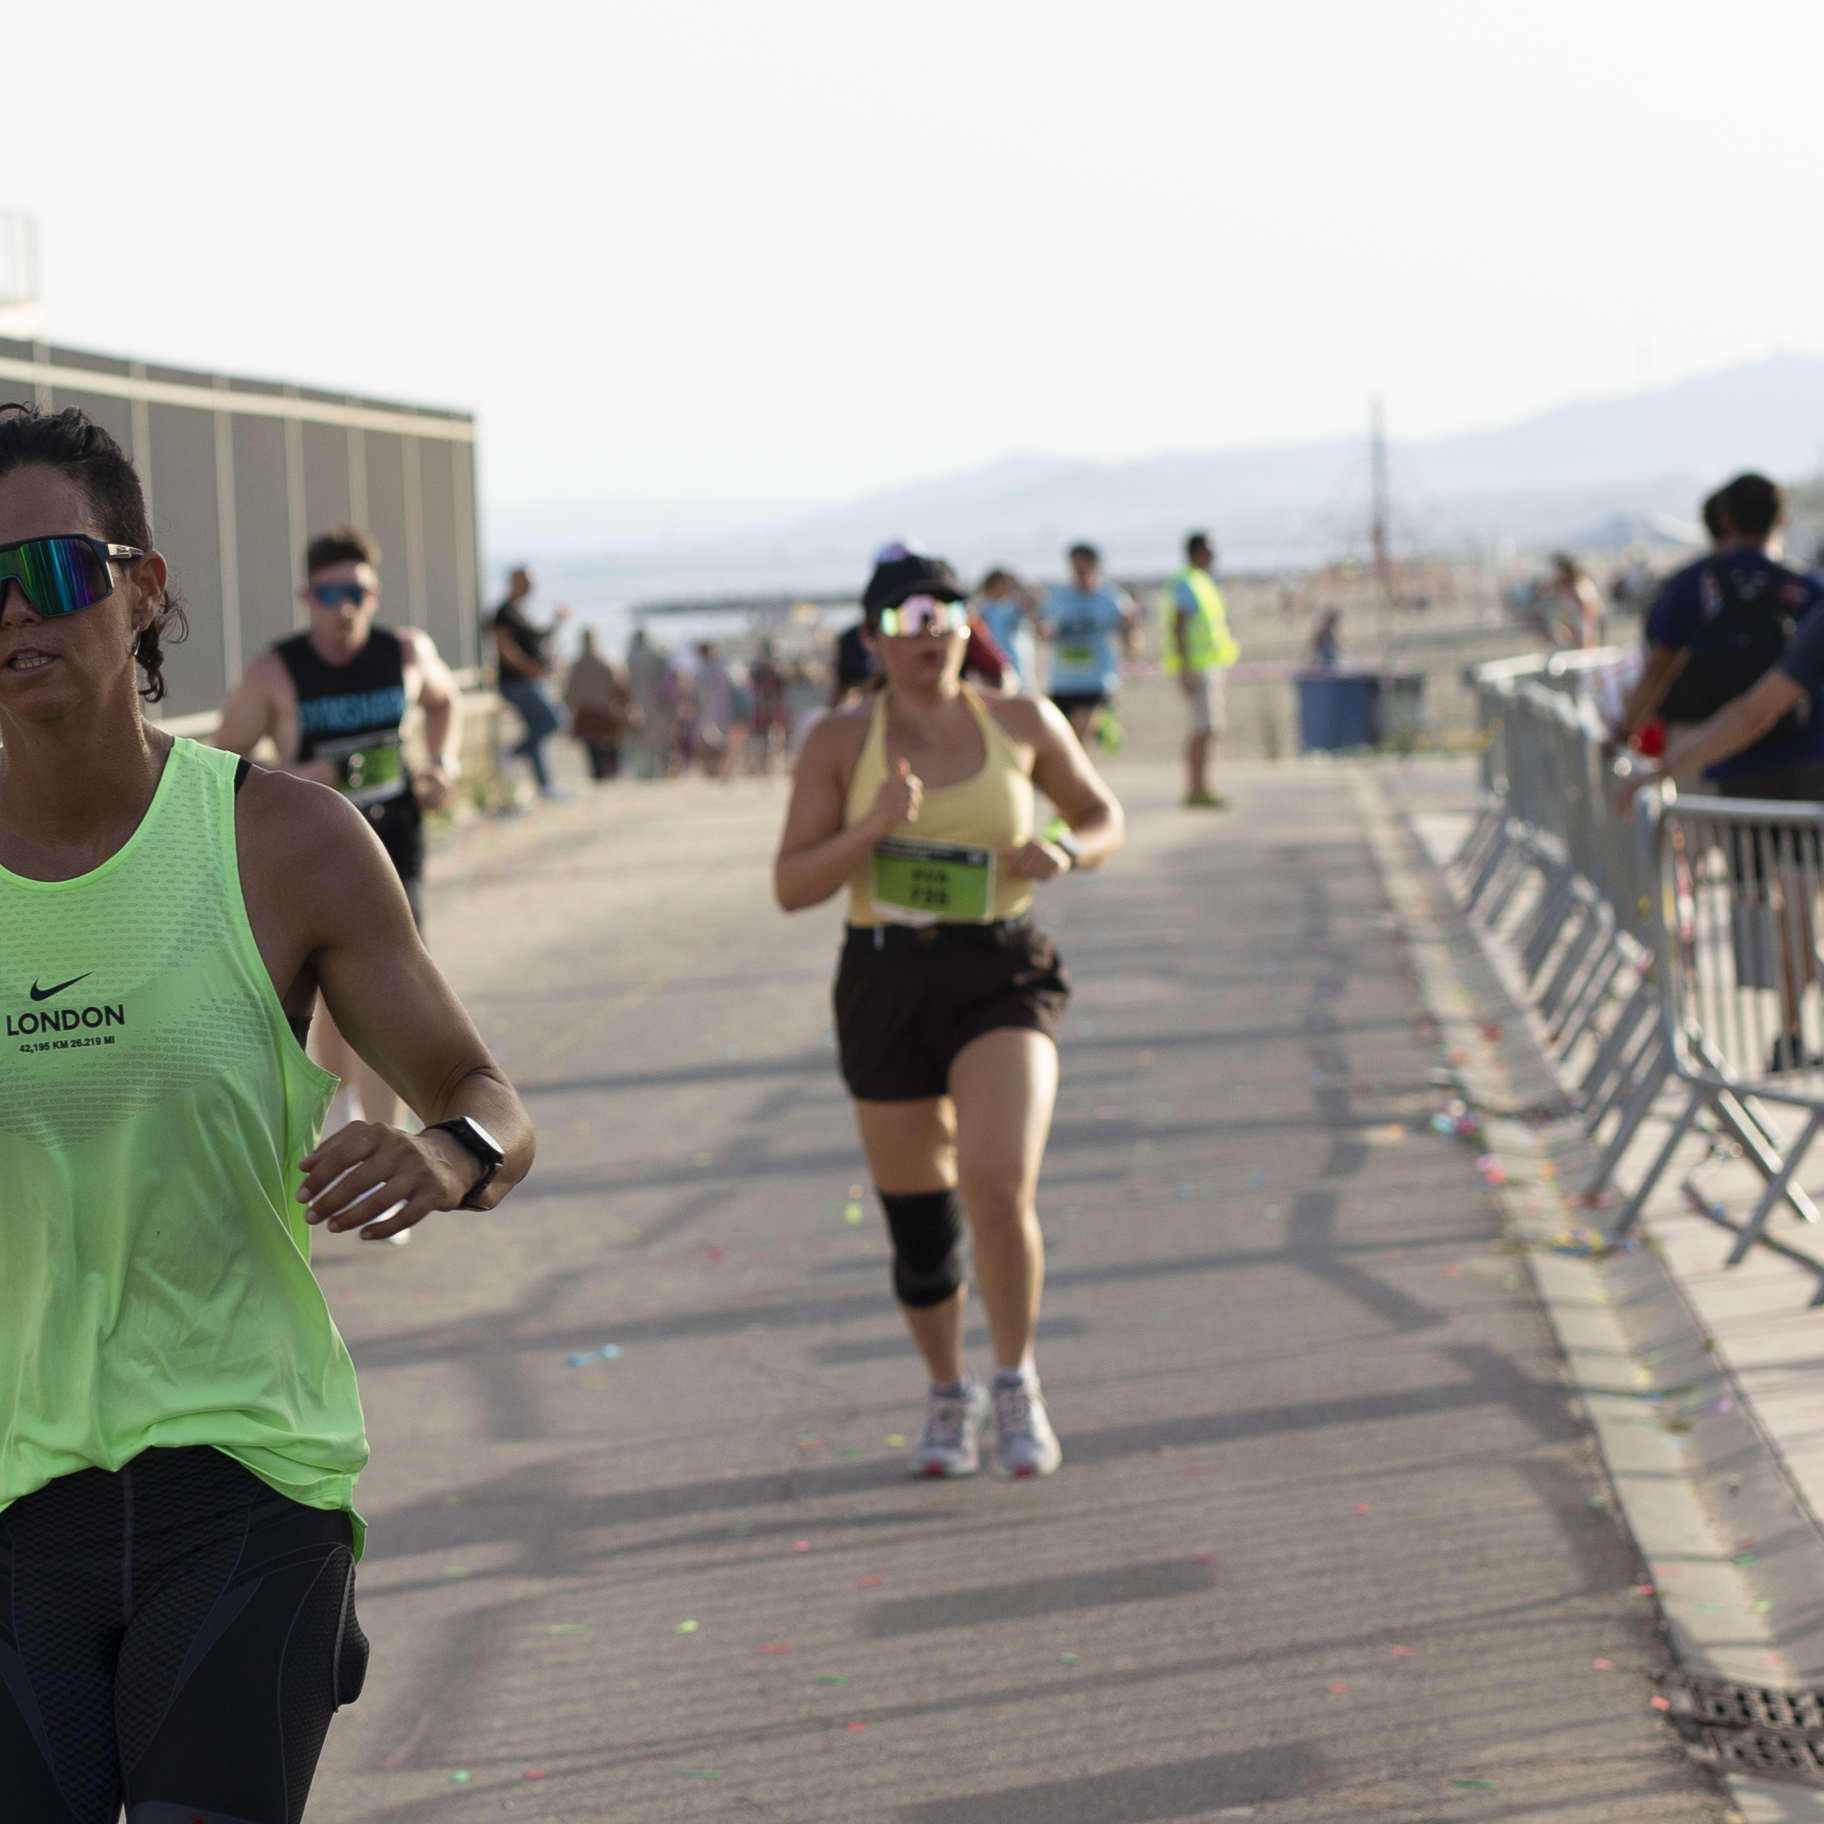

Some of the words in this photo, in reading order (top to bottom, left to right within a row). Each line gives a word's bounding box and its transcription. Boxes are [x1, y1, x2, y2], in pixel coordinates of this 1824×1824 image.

[6, 1004, 125, 1036] LONDON
[19, 1042, 51, 1054] 42,195
[52, 1040, 69, 1050] KM
[70, 1037, 102, 1048] 26.219
[103, 1035, 116, 1045] MI
